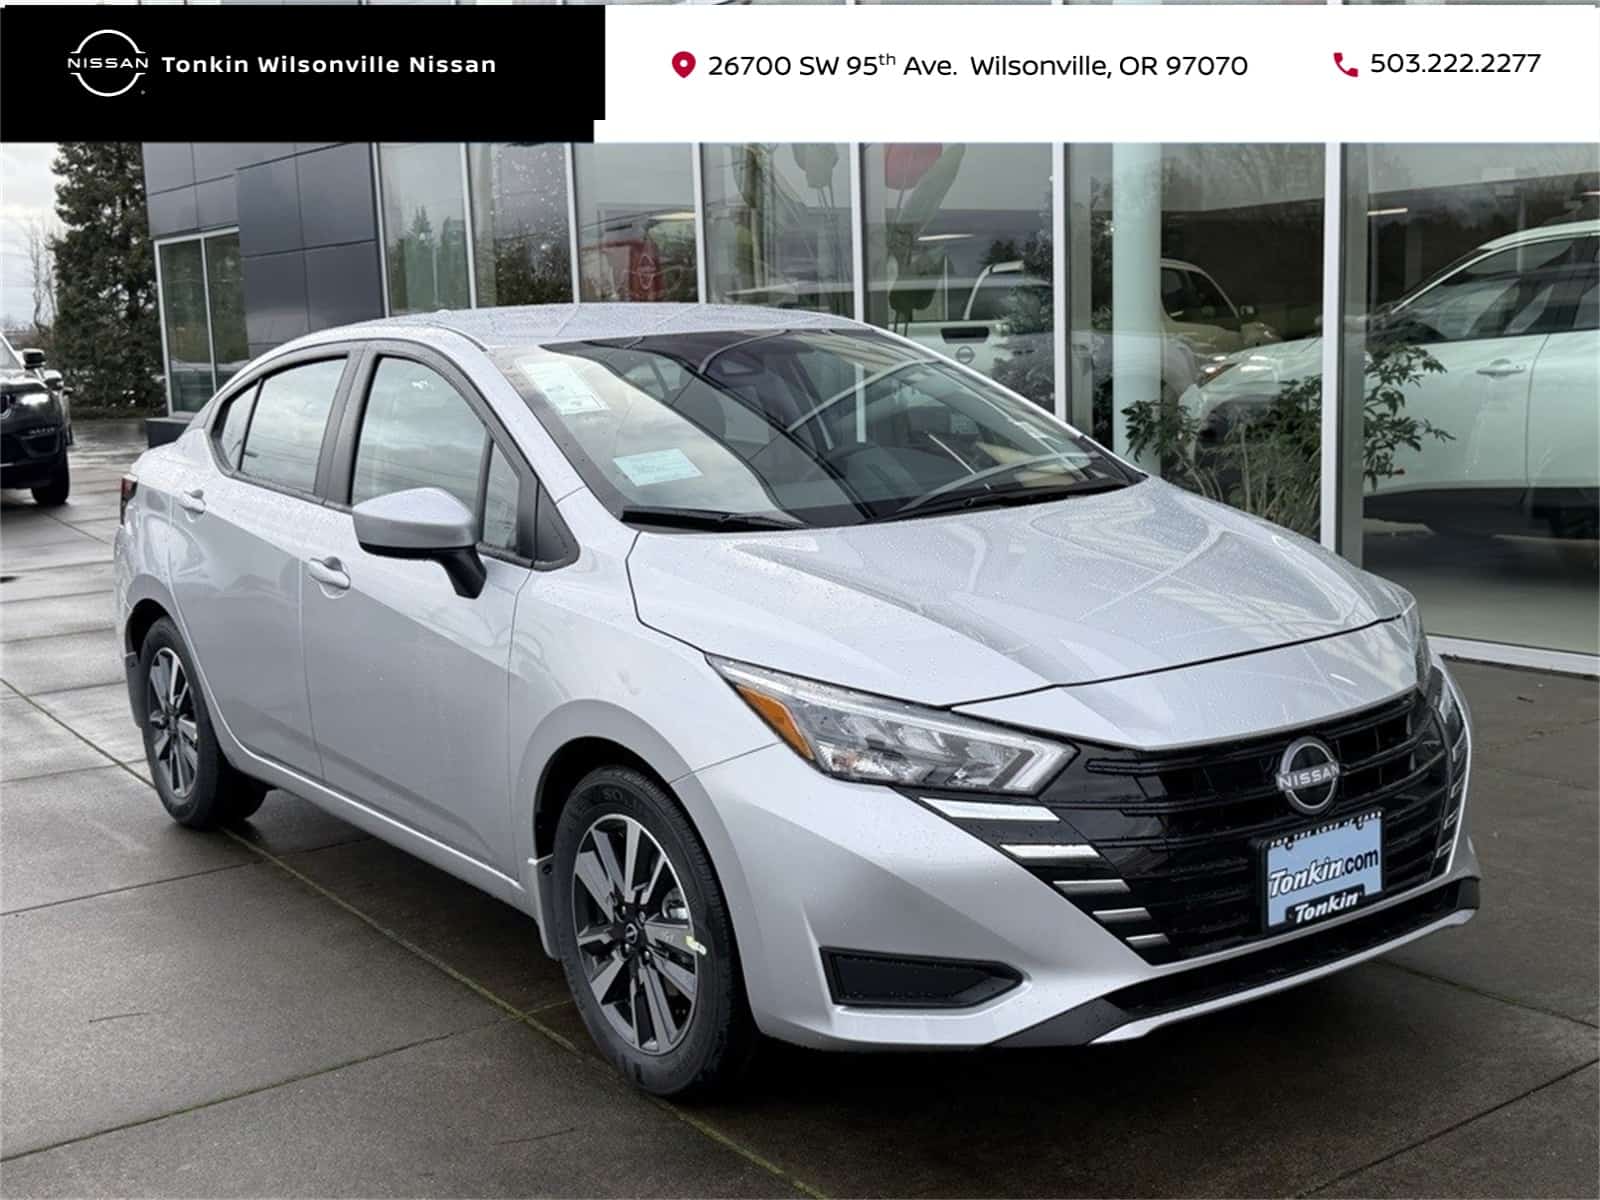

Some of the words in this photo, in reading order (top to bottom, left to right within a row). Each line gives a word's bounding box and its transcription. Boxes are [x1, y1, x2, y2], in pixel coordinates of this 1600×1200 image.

[1277, 762, 1341, 790] NISSAN
[1269, 850, 1379, 898] Tonkin.com
[1295, 891, 1360, 924] Tonkin
